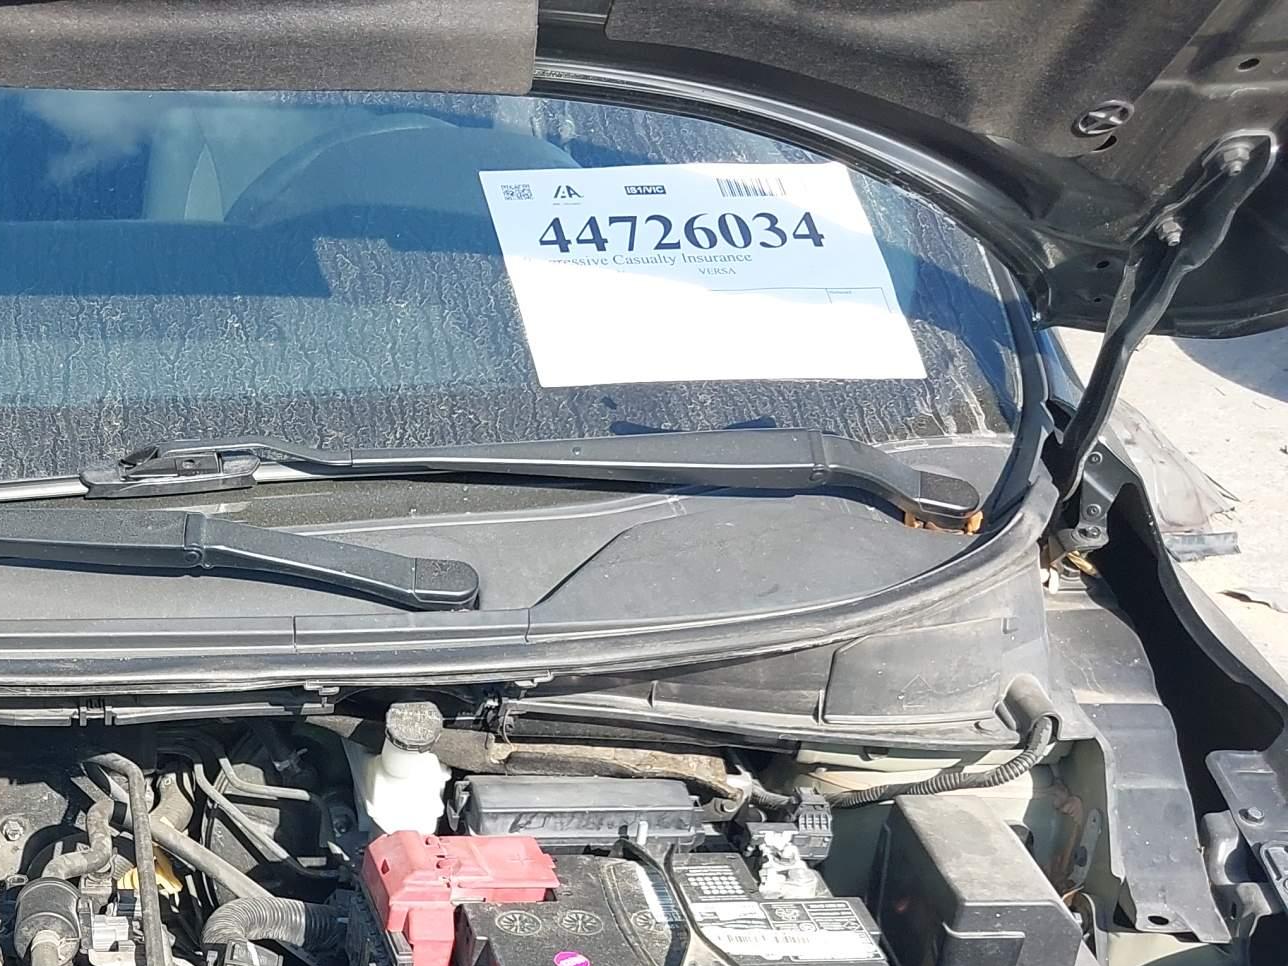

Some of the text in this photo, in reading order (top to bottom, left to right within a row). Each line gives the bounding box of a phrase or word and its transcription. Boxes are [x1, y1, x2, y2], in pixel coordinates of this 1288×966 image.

[539, 211, 825, 252] 44726034
[612, 253, 676, 266] Casualty
[682, 253, 752, 263] Insurance
